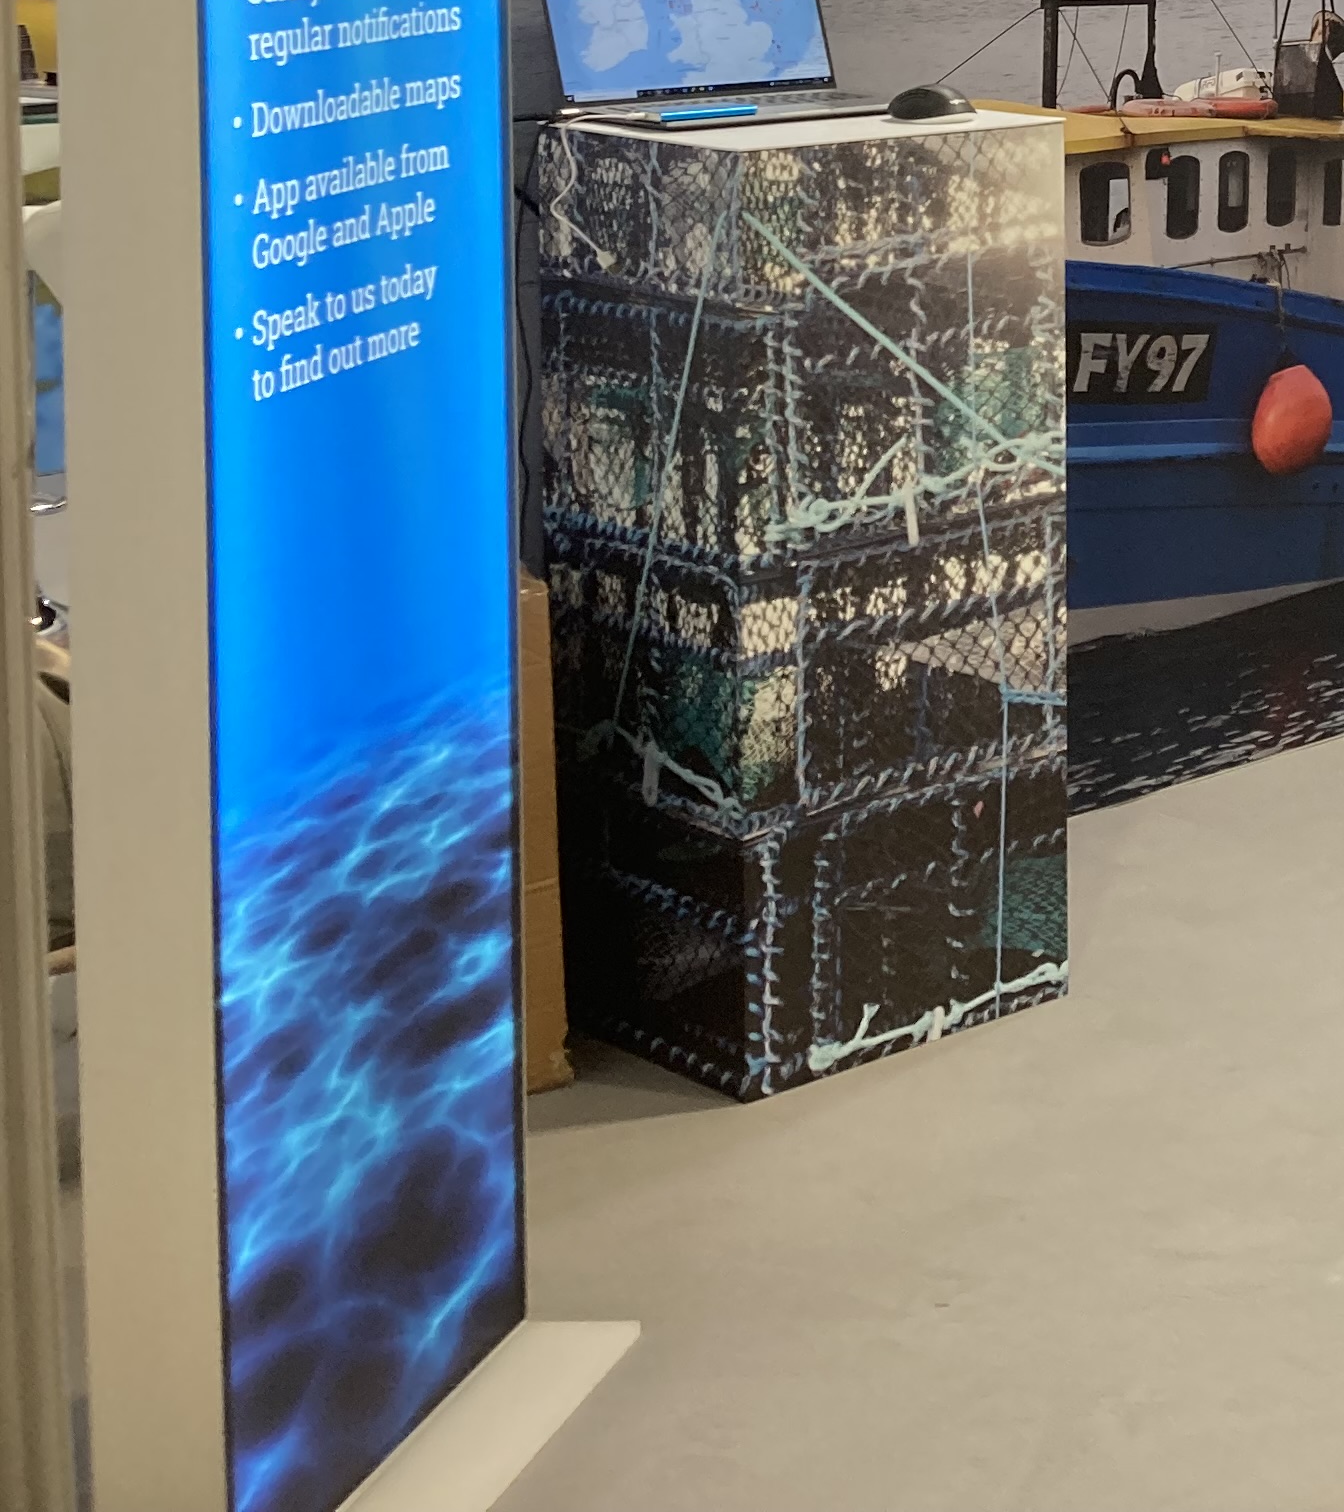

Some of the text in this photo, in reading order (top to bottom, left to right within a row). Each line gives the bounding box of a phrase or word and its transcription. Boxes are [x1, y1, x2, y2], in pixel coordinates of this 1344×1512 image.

[249, 1, 462, 66] regular notifications
[251, 74, 462, 138] Downloadable maps
[253, 144, 450, 219] App available from
[253, 192, 436, 269] Google and Apple
[253, 264, 438, 350] Speak to us today
[252, 322, 420, 401] to find out more
[1073, 331, 1211, 394] FY97
